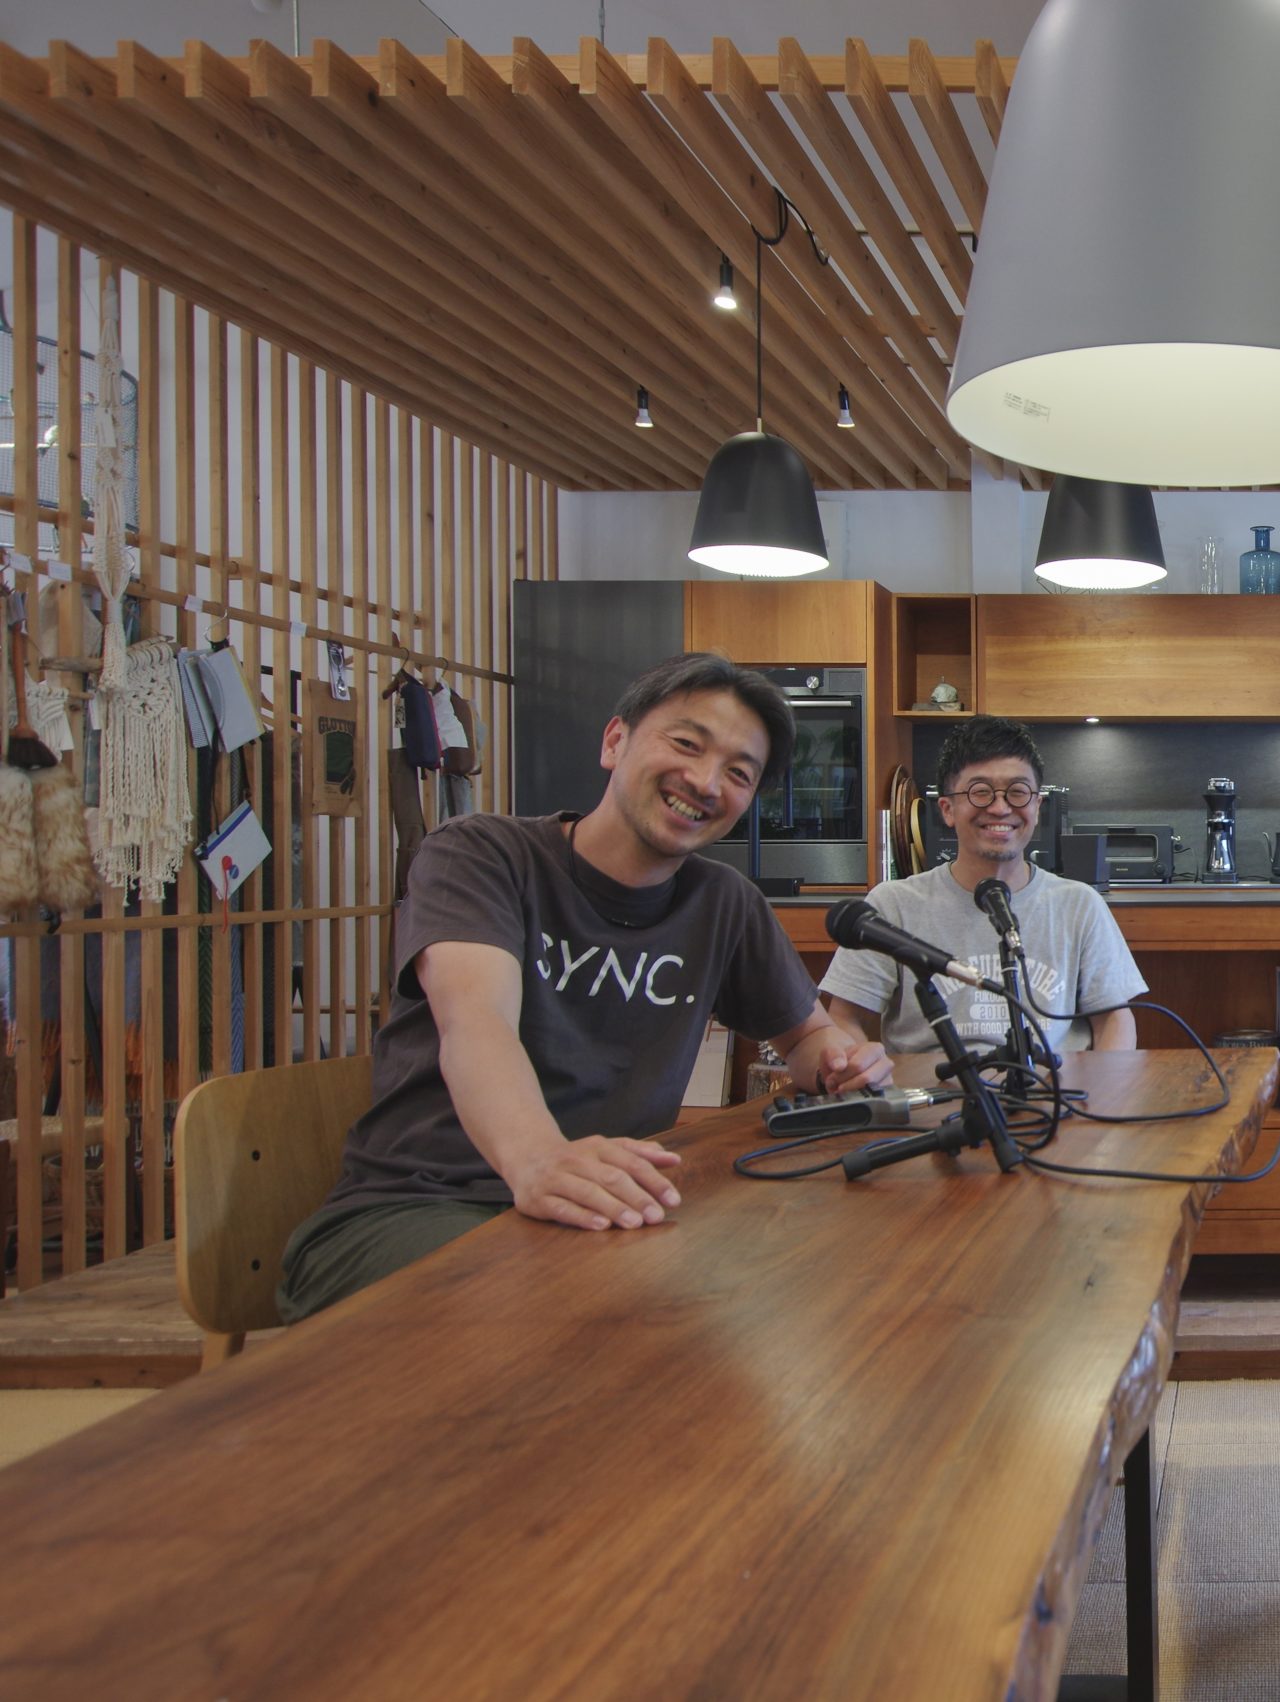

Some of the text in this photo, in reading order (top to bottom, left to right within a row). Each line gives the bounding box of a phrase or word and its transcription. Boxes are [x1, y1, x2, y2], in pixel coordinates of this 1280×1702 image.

[537, 932, 695, 1005] SYNC.
[979, 1006, 1007, 1019] 2010
[957, 1023, 980, 1036] WITH
[980, 1022, 1003, 1034] GOOD
